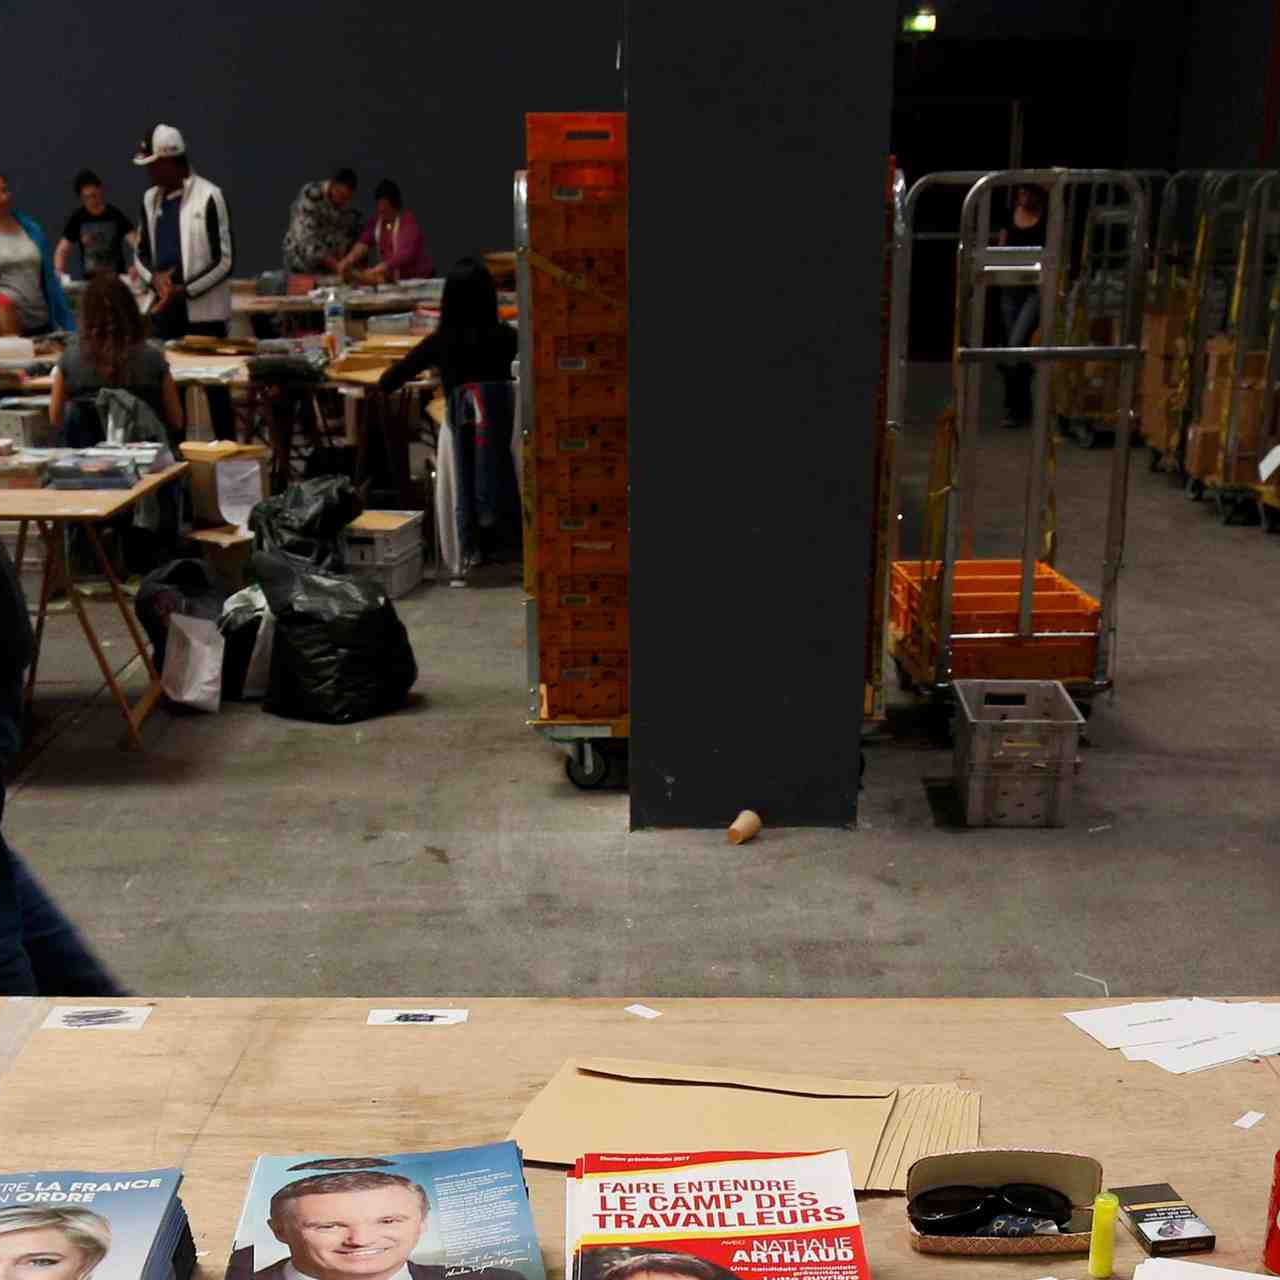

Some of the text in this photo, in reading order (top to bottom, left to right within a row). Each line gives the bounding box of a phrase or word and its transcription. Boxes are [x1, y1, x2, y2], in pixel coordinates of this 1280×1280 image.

[34, 1181, 63, 1193] LA
[70, 1178, 163, 1193] FRANCE
[599, 1179, 797, 1194] FAIRE ENTENDRE
[15, 1192, 97, 1204] ORDRE
[600, 1191, 819, 1212] LE CAMP DES
[592, 1206, 846, 1230] TRAVAILLEURS
[752, 1235, 852, 1252] NATHALIE
[732, 1247, 854, 1264] ARTHAUD
